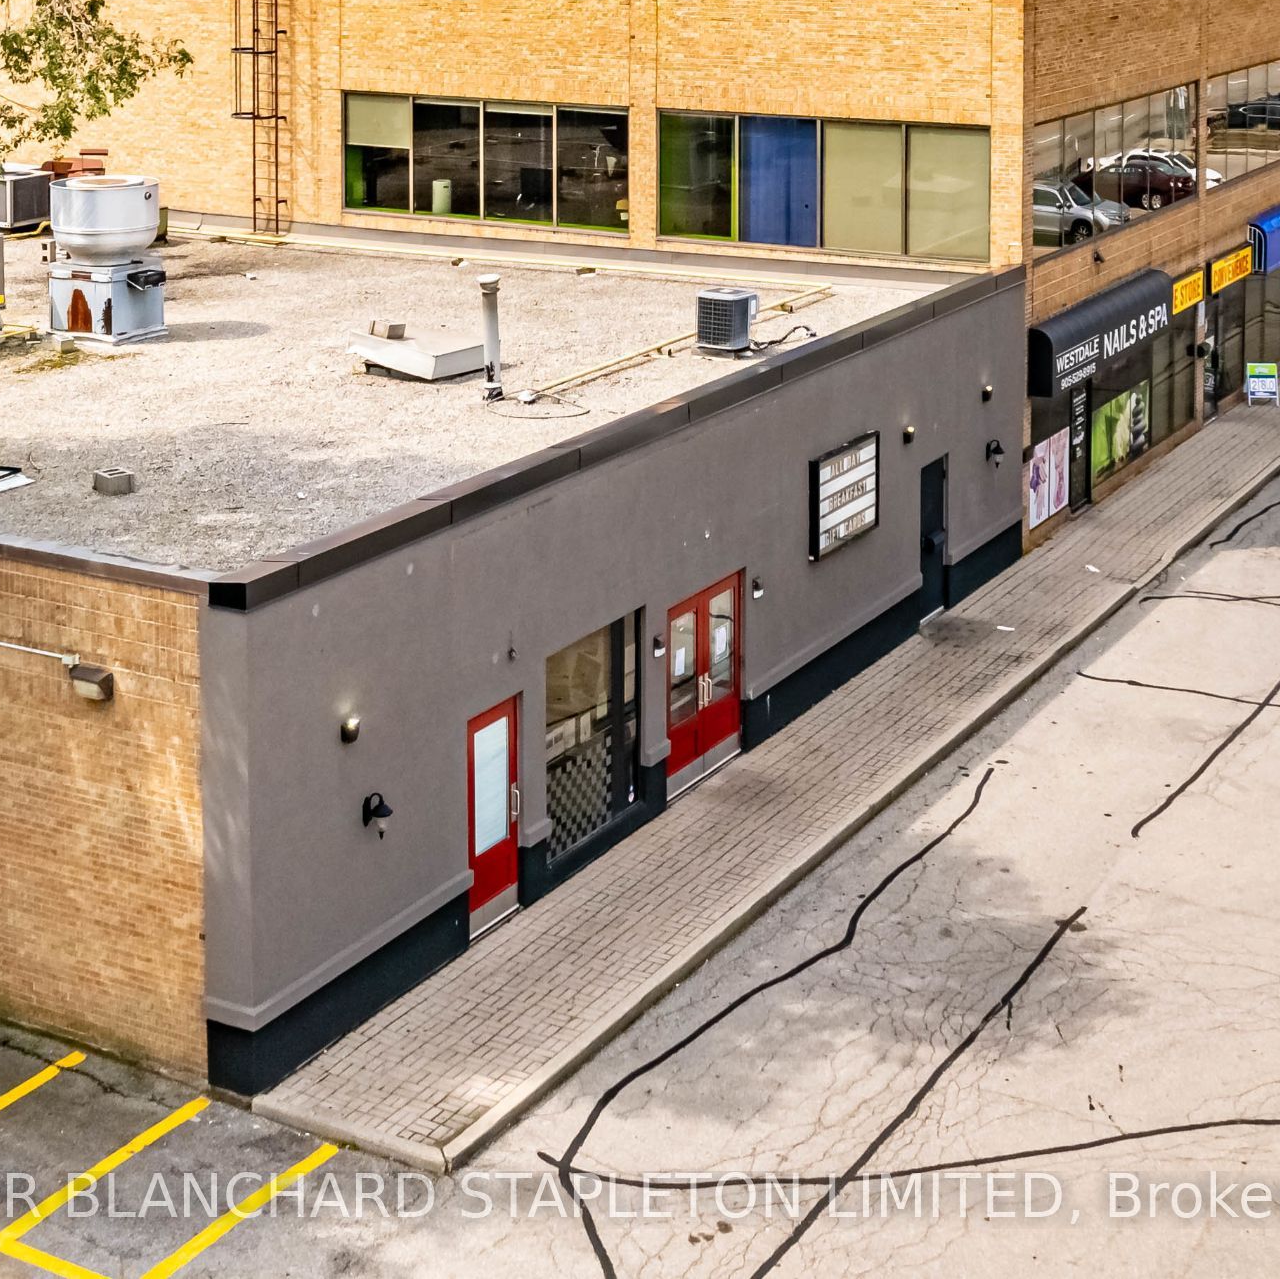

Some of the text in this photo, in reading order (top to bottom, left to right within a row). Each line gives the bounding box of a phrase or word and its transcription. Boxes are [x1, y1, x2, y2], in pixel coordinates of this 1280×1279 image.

[1213, 253, 1249, 291] CONVENIENCE
[1181, 277, 1201, 307] STORE
[1056, 302, 1168, 373] WESTDALE NAILS & SPA
[830, 452, 861, 478] ALL DAY
[828, 480, 868, 511] BREAKFAST
[825, 512, 866, 546] GIFT CARDS
